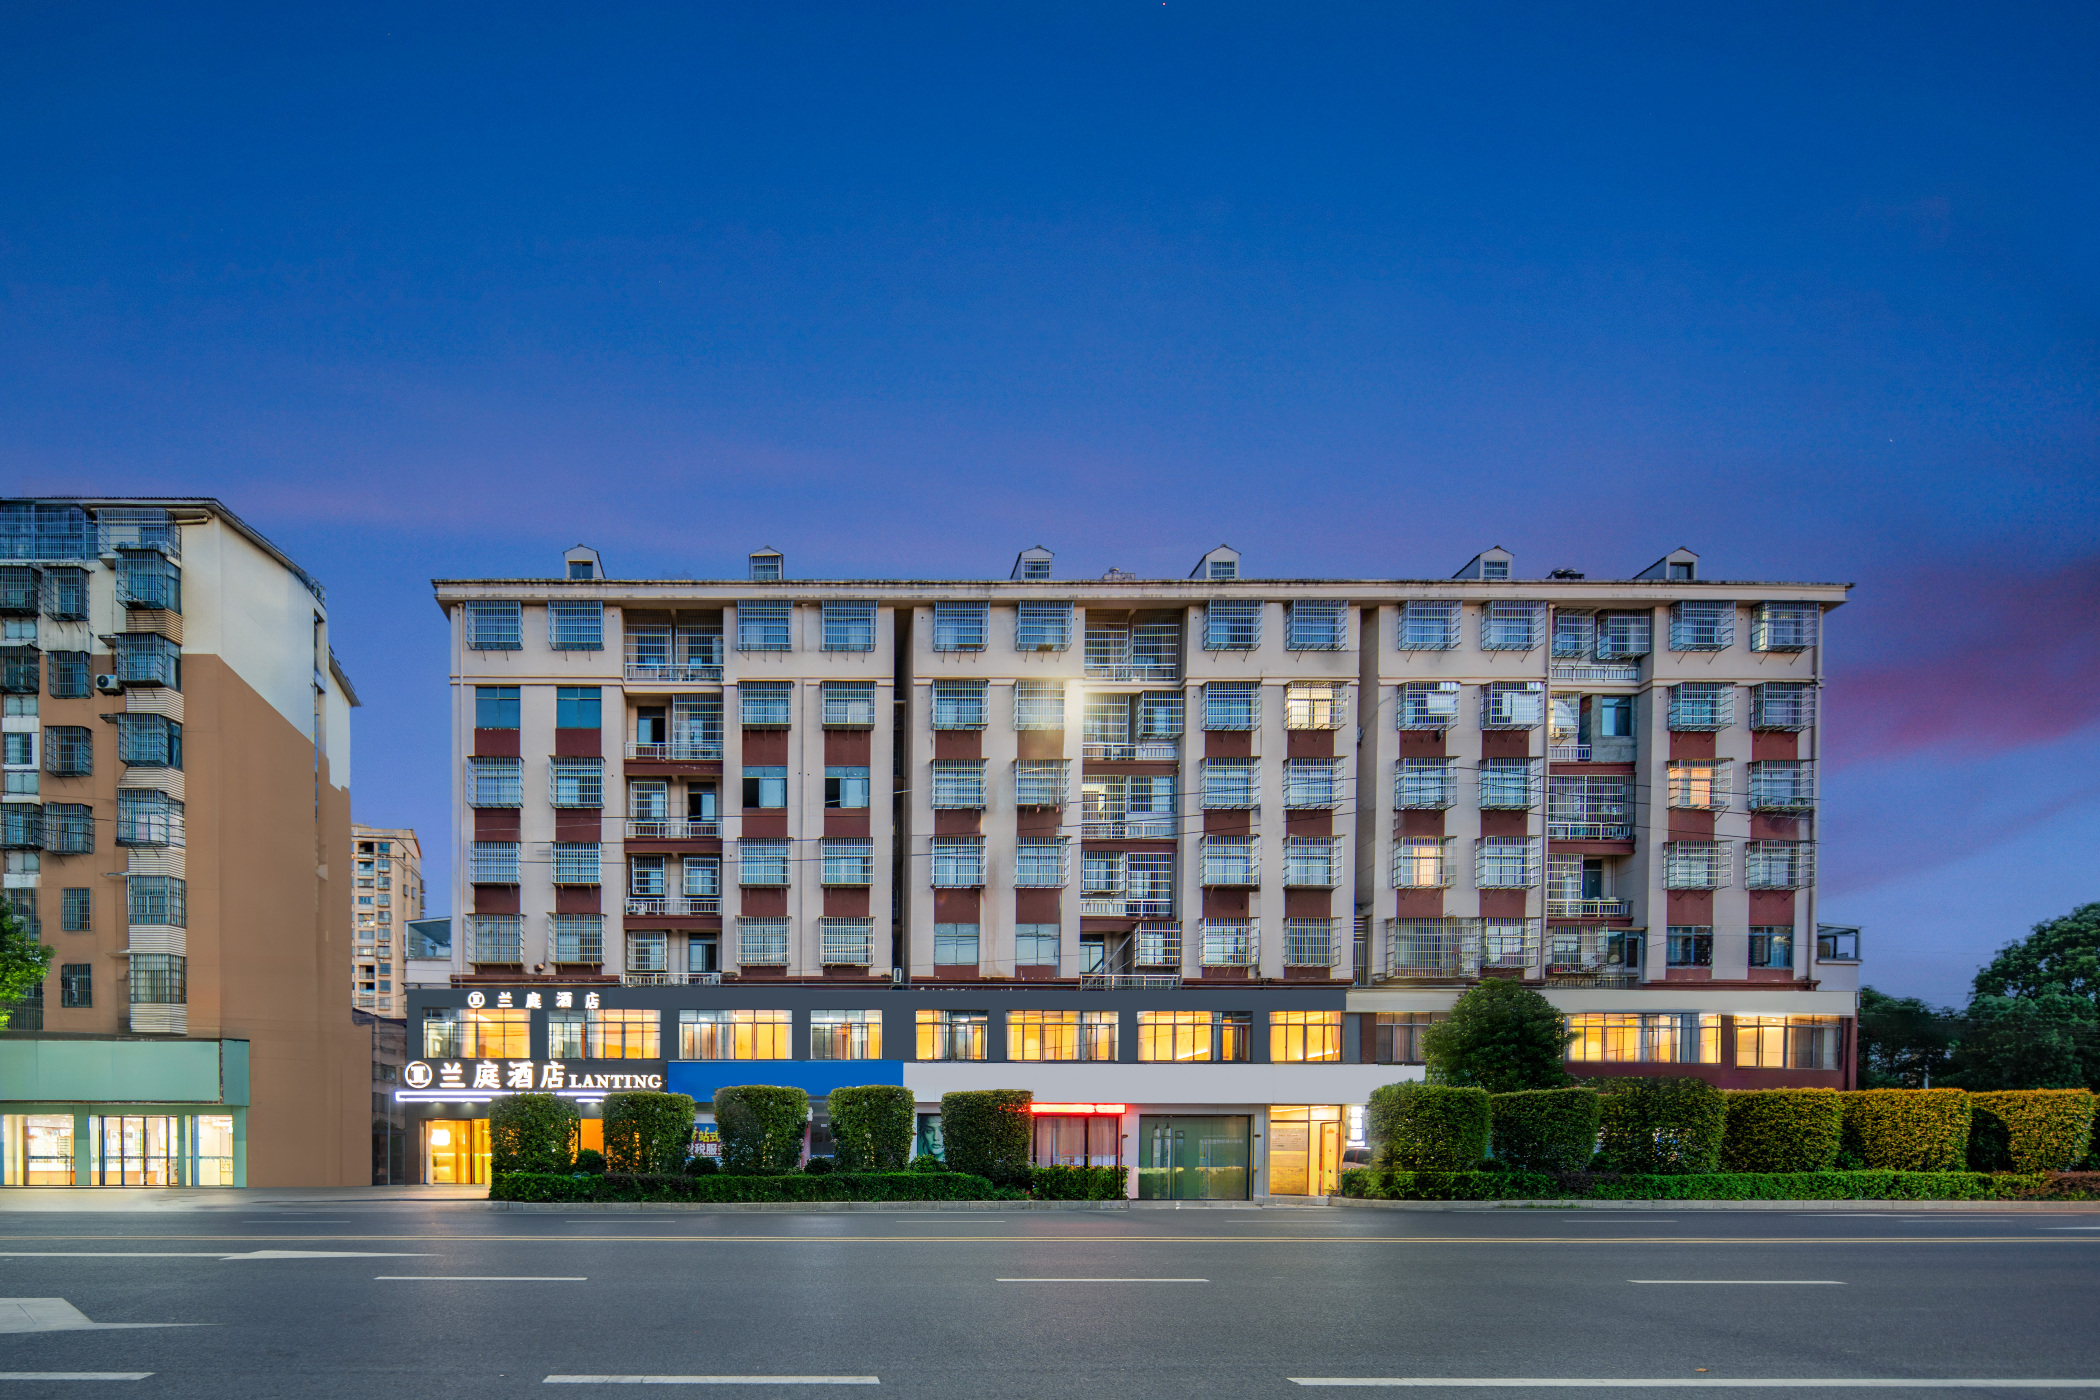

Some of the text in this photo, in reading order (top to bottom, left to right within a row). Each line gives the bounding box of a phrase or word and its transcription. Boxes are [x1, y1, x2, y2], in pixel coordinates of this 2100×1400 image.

[497, 991, 600, 1009] 兰庭酒店
[439, 1060, 662, 1089] 兰庭酒店 LANTING
